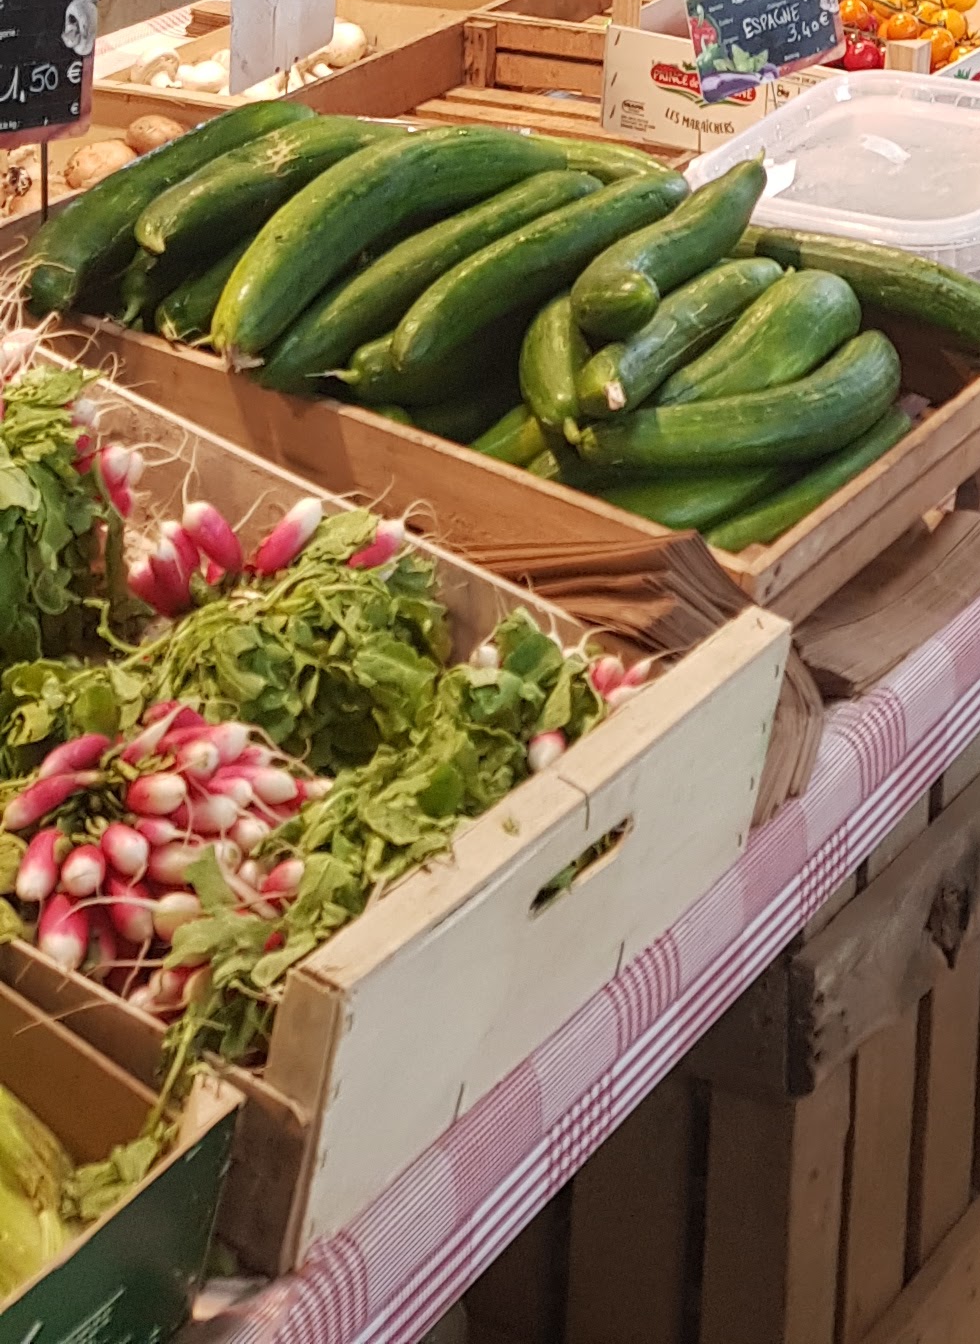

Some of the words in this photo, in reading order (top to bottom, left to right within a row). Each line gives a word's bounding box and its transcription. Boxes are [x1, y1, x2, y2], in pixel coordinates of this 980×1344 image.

[742, 3, 800, 39] ESPAGNE
[653, 70, 689, 87] PRINCE
[665, 107, 680, 124] LES
